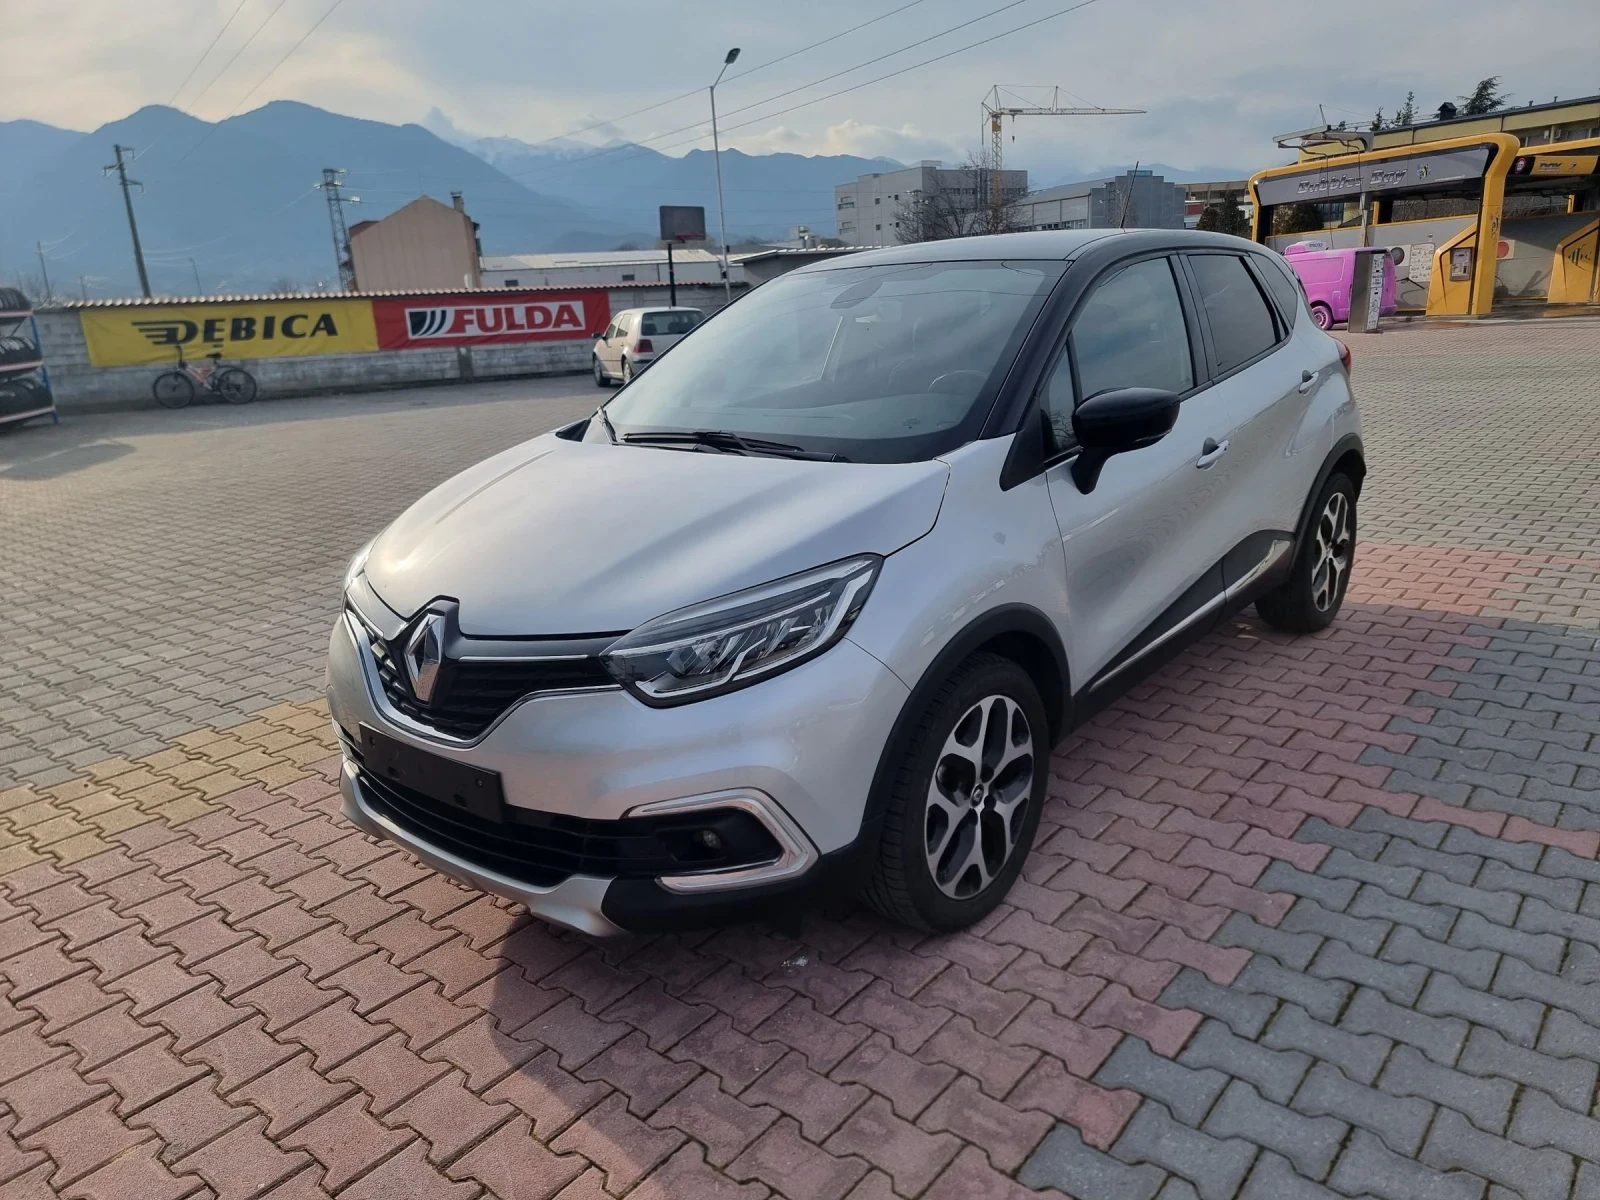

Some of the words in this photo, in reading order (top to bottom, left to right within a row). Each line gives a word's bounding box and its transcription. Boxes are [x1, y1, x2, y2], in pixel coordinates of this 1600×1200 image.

[1297, 174, 1364, 194] Bubbles
[1369, 169, 1407, 185] Bay
[444, 304, 583, 335] FULDA
